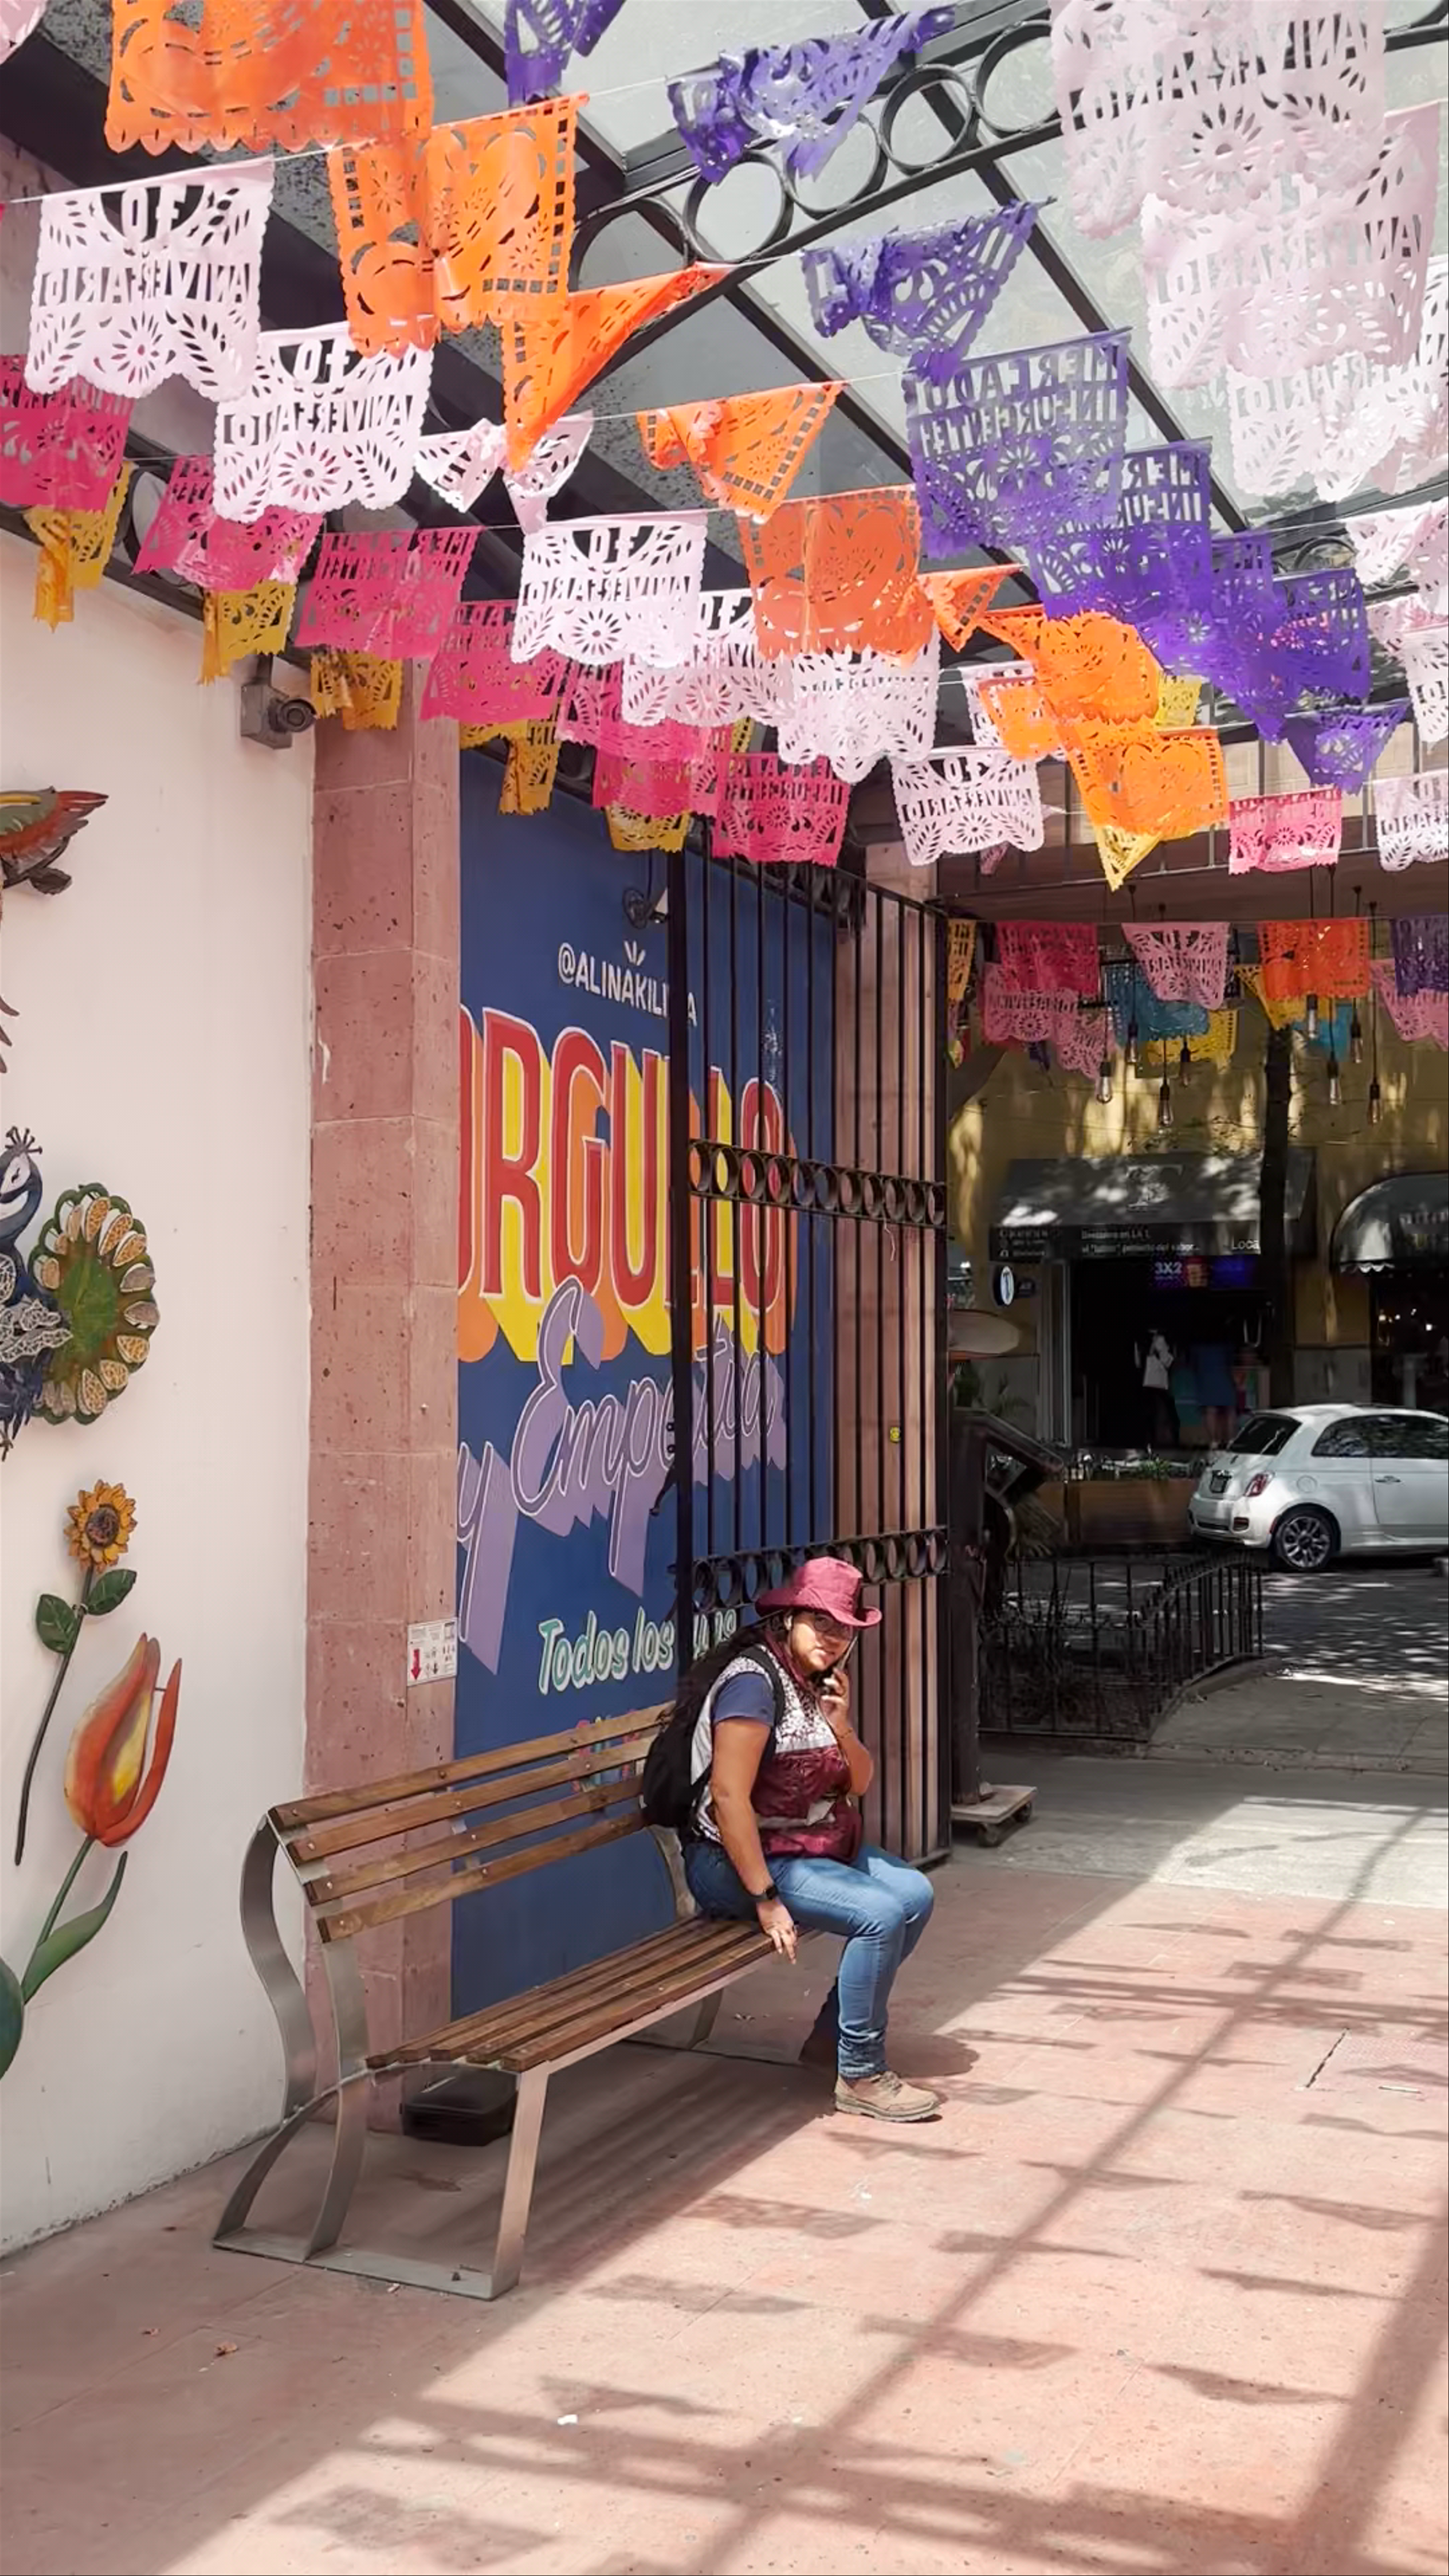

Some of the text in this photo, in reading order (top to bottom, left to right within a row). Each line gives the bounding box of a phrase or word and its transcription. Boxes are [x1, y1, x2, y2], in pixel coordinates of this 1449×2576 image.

[558, 942, 697, 1027] @ALINAKILIA
[538, 1610, 629, 1695] Todos
[632, 1606, 675, 1673] los
